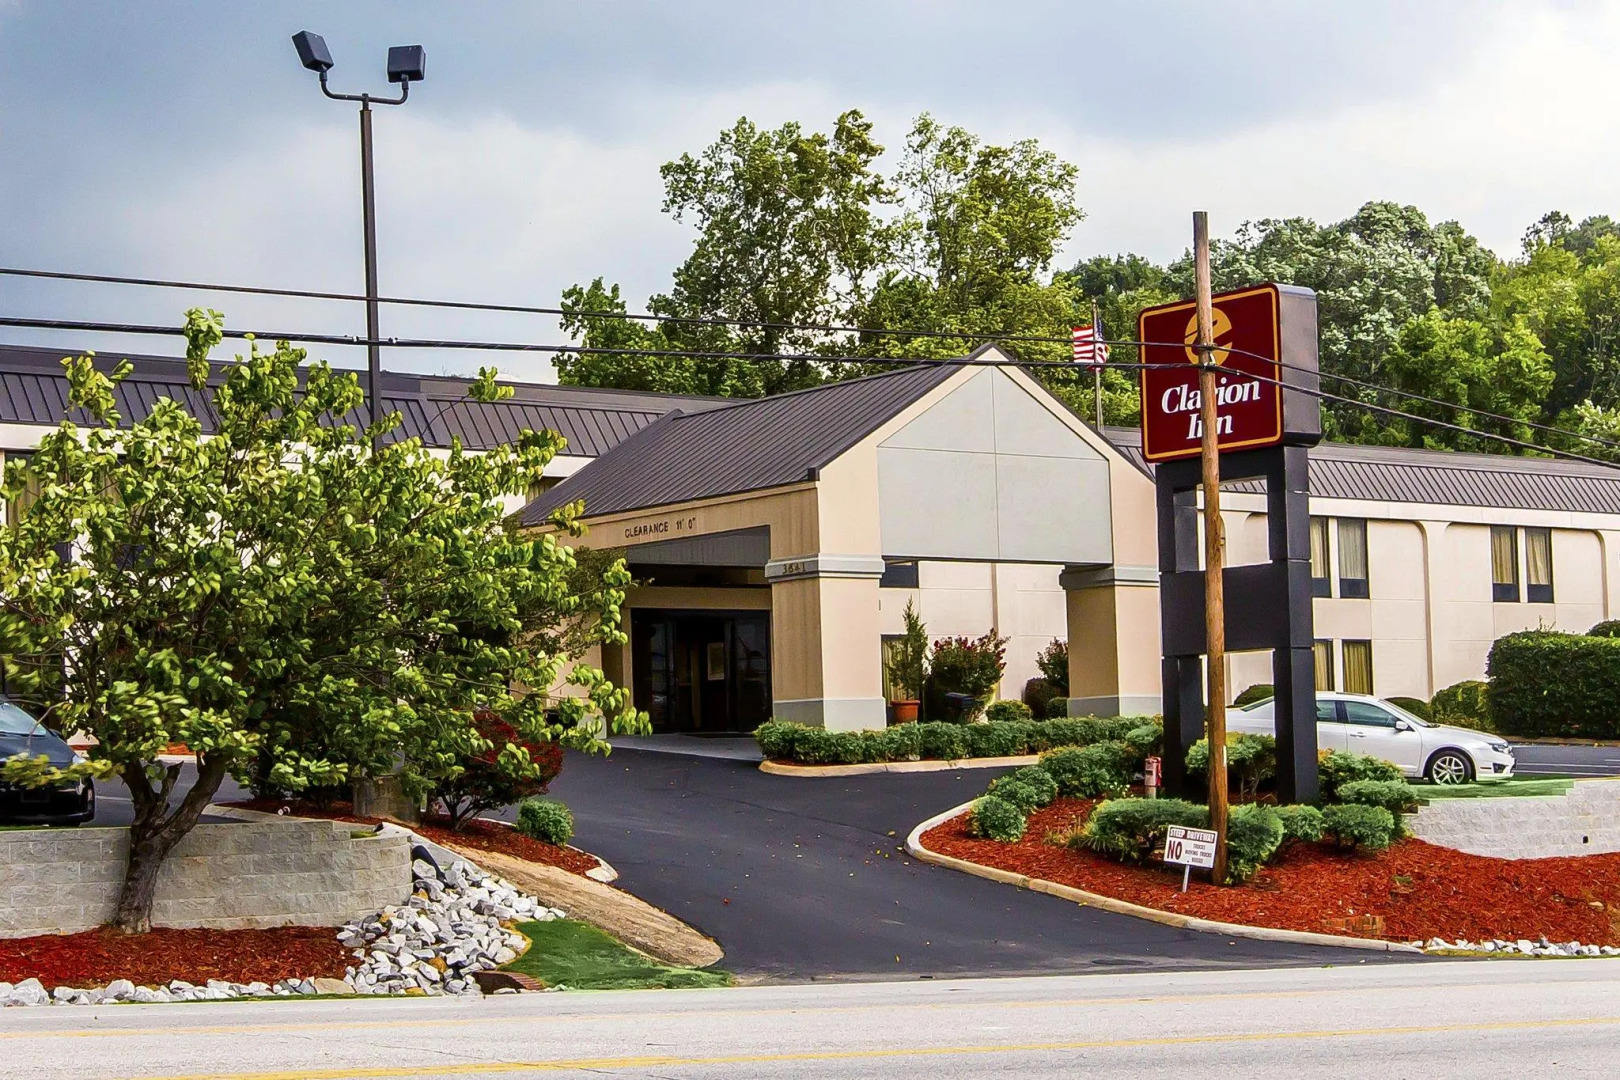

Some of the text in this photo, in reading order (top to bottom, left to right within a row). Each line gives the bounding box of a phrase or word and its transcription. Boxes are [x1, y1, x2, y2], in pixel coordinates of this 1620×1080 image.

[1161, 377, 1260, 414] Claion
[624, 521, 669, 538] CLEARANCE
[1167, 840, 1182, 860] NO
